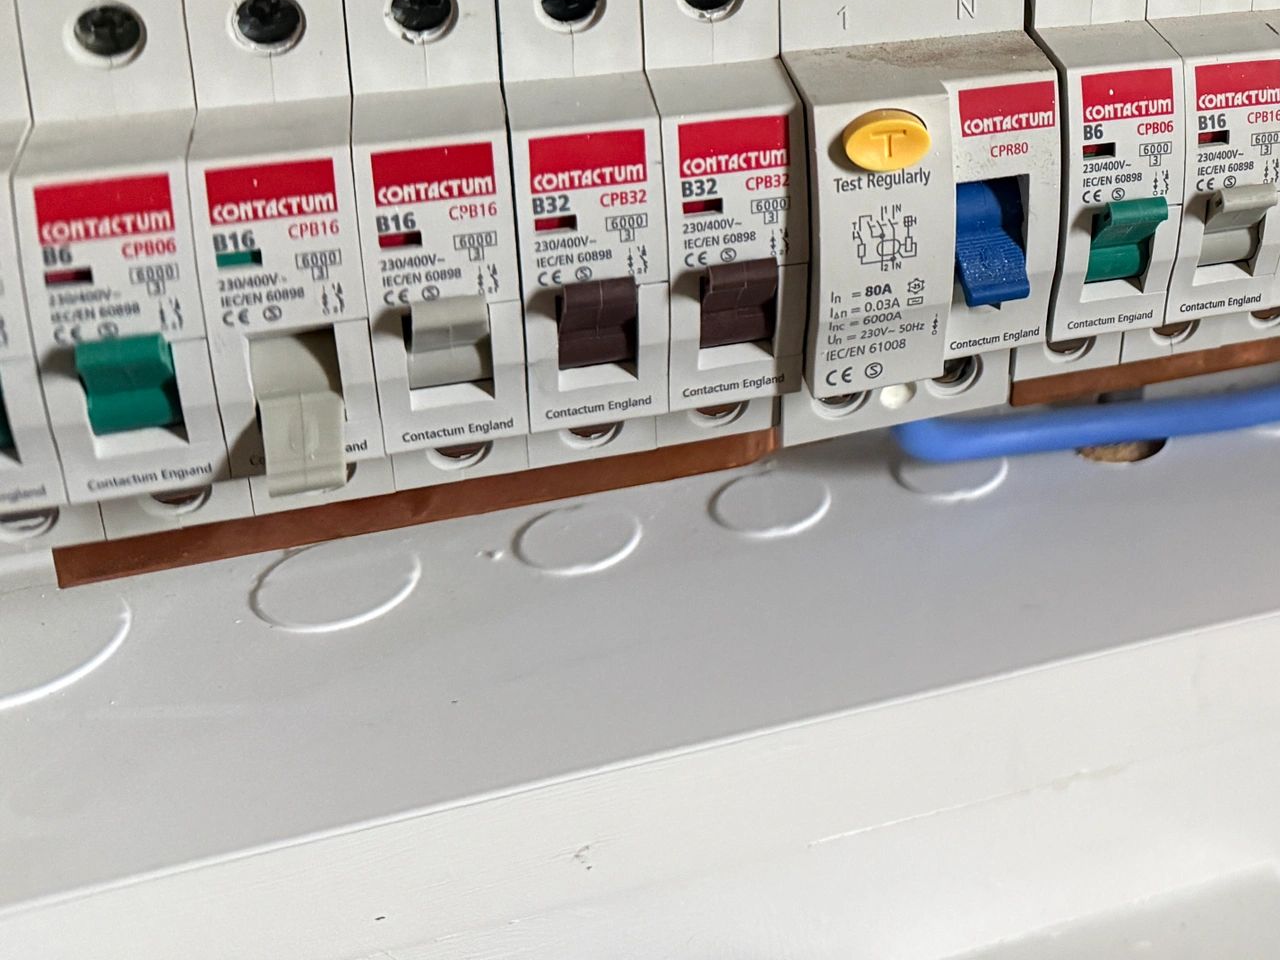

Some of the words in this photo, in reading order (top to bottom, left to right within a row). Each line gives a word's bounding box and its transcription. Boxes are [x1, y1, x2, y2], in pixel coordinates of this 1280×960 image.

[1199, 87, 1280, 109] CONTACTUM
[1085, 98, 1172, 120] CONTACTUM
[963, 110, 1054, 135] CONTACTUM
[1083, 124, 1103, 140] B6
[1137, 120, 1174, 136] CPB06
[1198, 113, 1226, 130] B16
[870, 128, 908, 159] T
[1143, 143, 1169, 154] 6000
[1255, 132, 1279, 144] 6000
[990, 142, 1029, 158] CPR80
[682, 148, 788, 175] CONTACTUM
[1197, 164, 1226, 176] IEC/EN
[1228, 160, 1254, 172] 60898
[533, 163, 644, 191] CONTACTUM
[682, 178, 717, 198] B32
[745, 173, 790, 191] CPB32
[833, 172, 863, 193] Test
[866, 167, 931, 190] Regularly
[1083, 175, 1113, 188] IEC/EN
[1115, 172, 1142, 184] 60898
[377, 176, 493, 204] CONTACTUM
[212, 192, 335, 222] CONTACTUM
[532, 194, 570, 215] B32
[600, 189, 647, 207] CPB32
[756, 198, 787, 213] 6000
[41, 209, 172, 243] CONTACTUM
[376, 211, 417, 233] B16
[449, 201, 498, 221] CPB16
[611, 215, 644, 230] 6000
[212, 230, 255, 252] B16
[288, 219, 340, 240] CPB16
[459, 232, 493, 248] 6000
[684, 234, 720, 249] IEC/EN
[723, 231, 756, 245] 60898
[536, 254, 575, 269] IEC/EN
[578, 249, 613, 263] 60898
[382, 271, 422, 288] IEC/EN
[425, 267, 462, 282] 60898
[220, 292, 263, 308] IEC/EN
[266, 287, 305, 303] 60898
[865, 283, 892, 298] 80A
[864, 297, 901, 313] 0.03A
[1179, 297, 1226, 313] Contactum
[1227, 293, 1262, 307] England
[863, 310, 902, 326] 6000A
[899, 321, 925, 334] 50Hz
[950, 333, 1000, 351] Contactum
[1003, 326, 1040, 342] England
[825, 345, 866, 362] IEC/EN
[868, 338, 906, 355] 61008
[682, 381, 740, 398] Contactum
[742, 373, 785, 392] England
[545, 403, 606, 420] Contactum
[607, 395, 653, 413] England
[401, 425, 465, 443] Contactum
[468, 417, 514, 436] England
